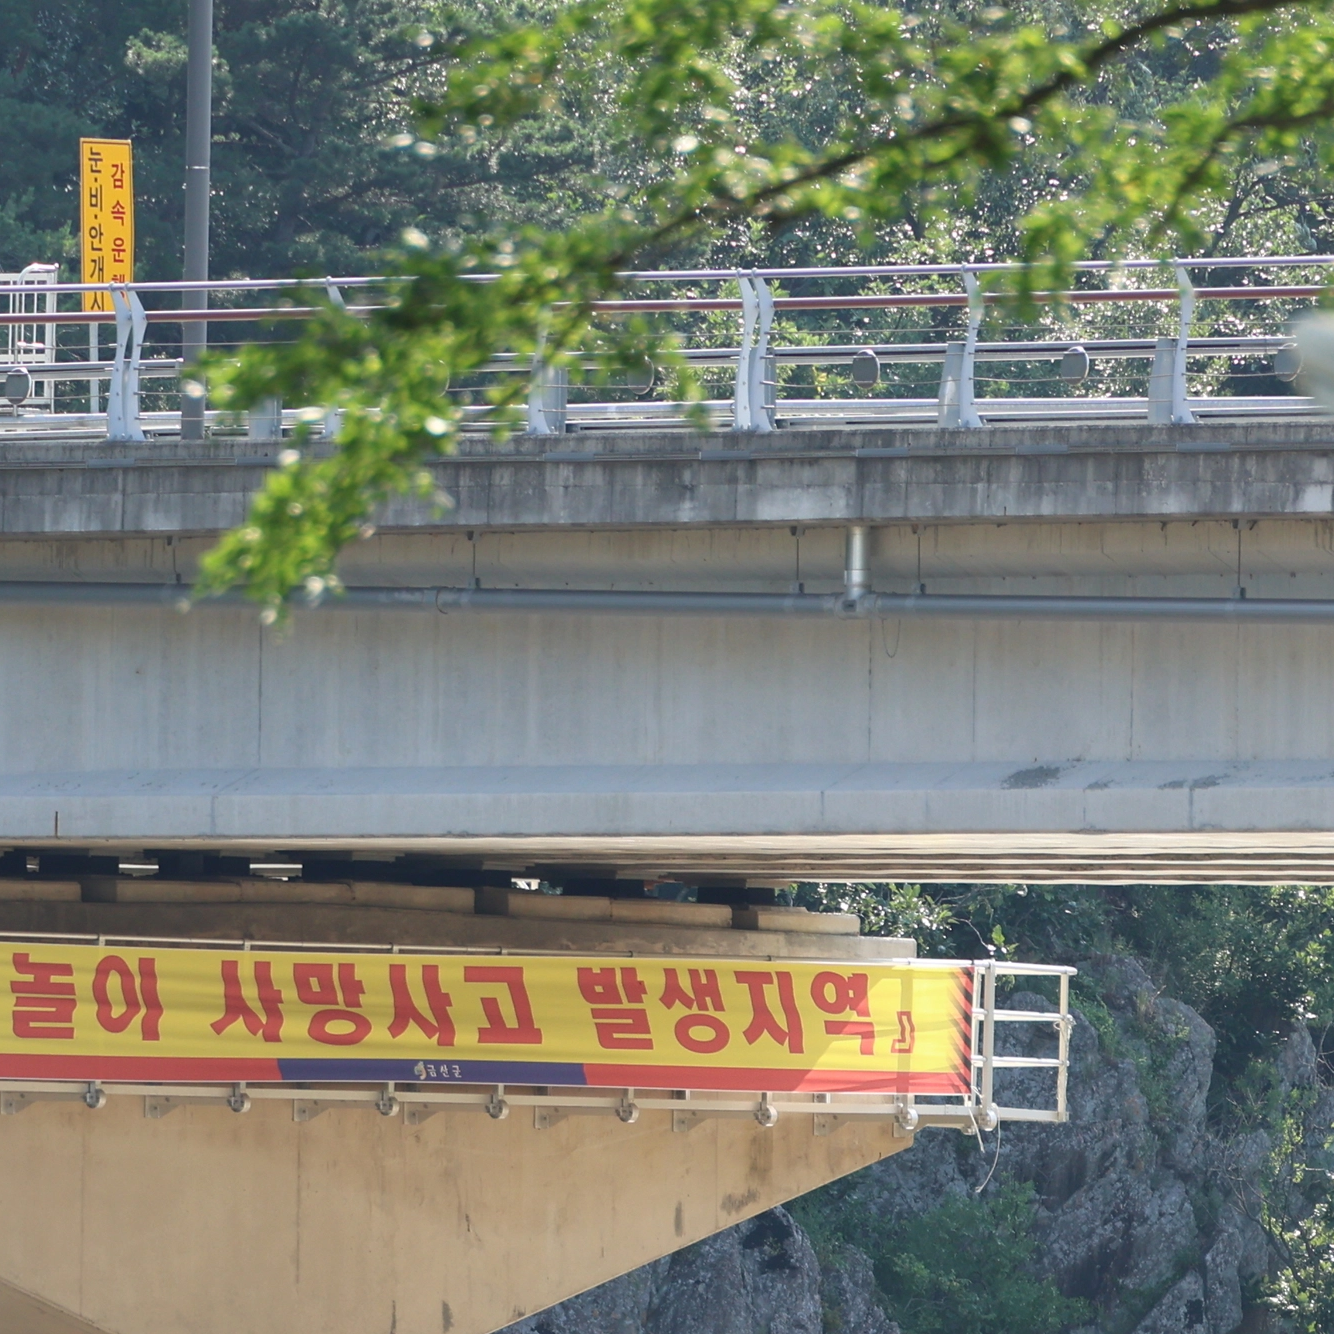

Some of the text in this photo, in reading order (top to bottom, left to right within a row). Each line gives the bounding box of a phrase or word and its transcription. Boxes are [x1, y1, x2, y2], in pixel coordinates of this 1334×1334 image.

[210, 959, 544, 1047] 사망사고
[577, 965, 916, 1057] 발생지역』
[426, 1064, 462, 1078] 금산군
